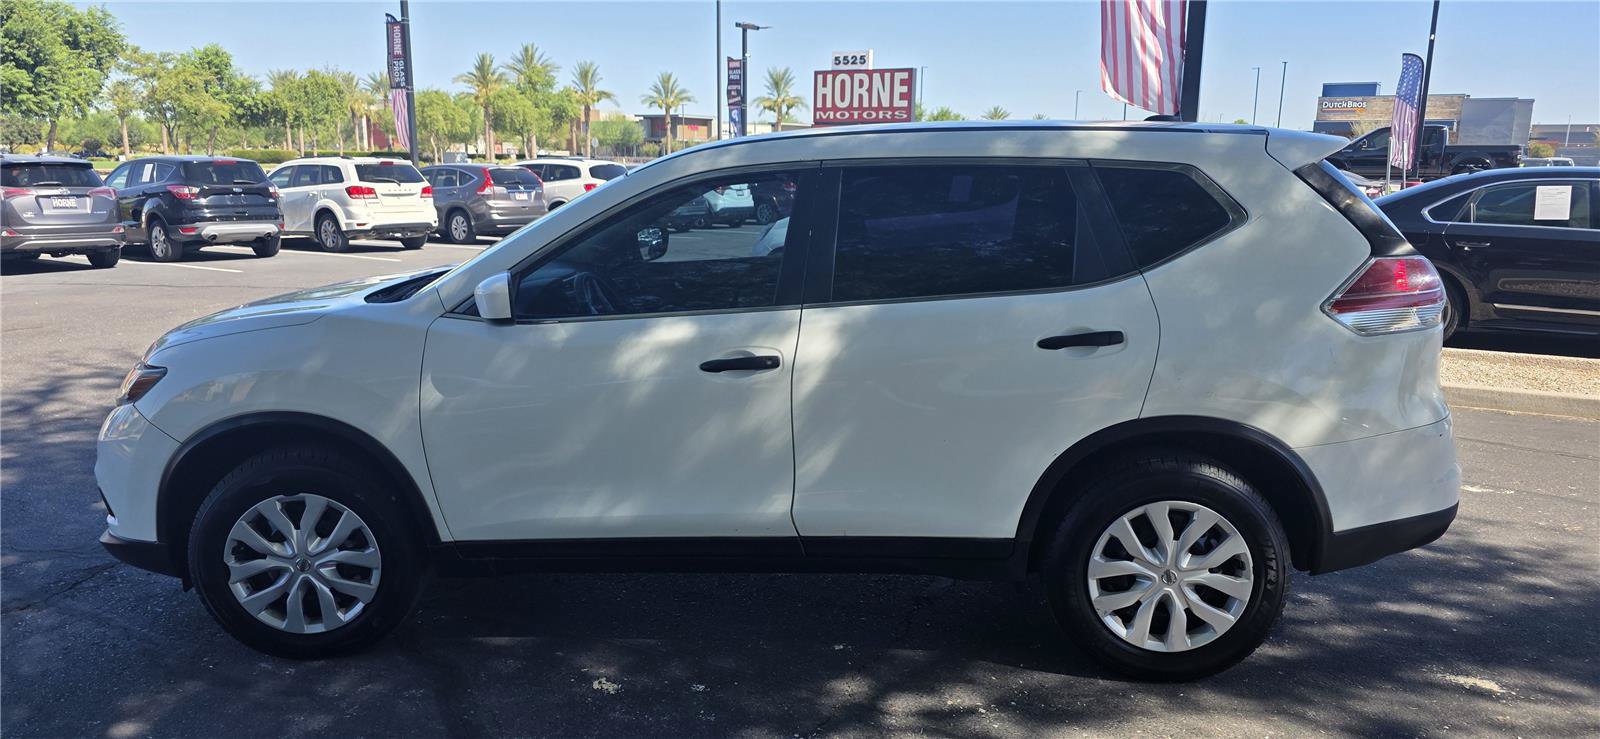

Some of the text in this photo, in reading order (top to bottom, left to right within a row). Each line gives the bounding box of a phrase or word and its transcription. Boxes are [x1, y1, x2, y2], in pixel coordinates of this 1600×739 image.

[393, 25, 402, 56] HORNE
[834, 55, 867, 65] 5525
[816, 72, 909, 108] HORNE
[816, 110, 908, 119] MOTORS
[52, 198, 77, 207] HORNE
